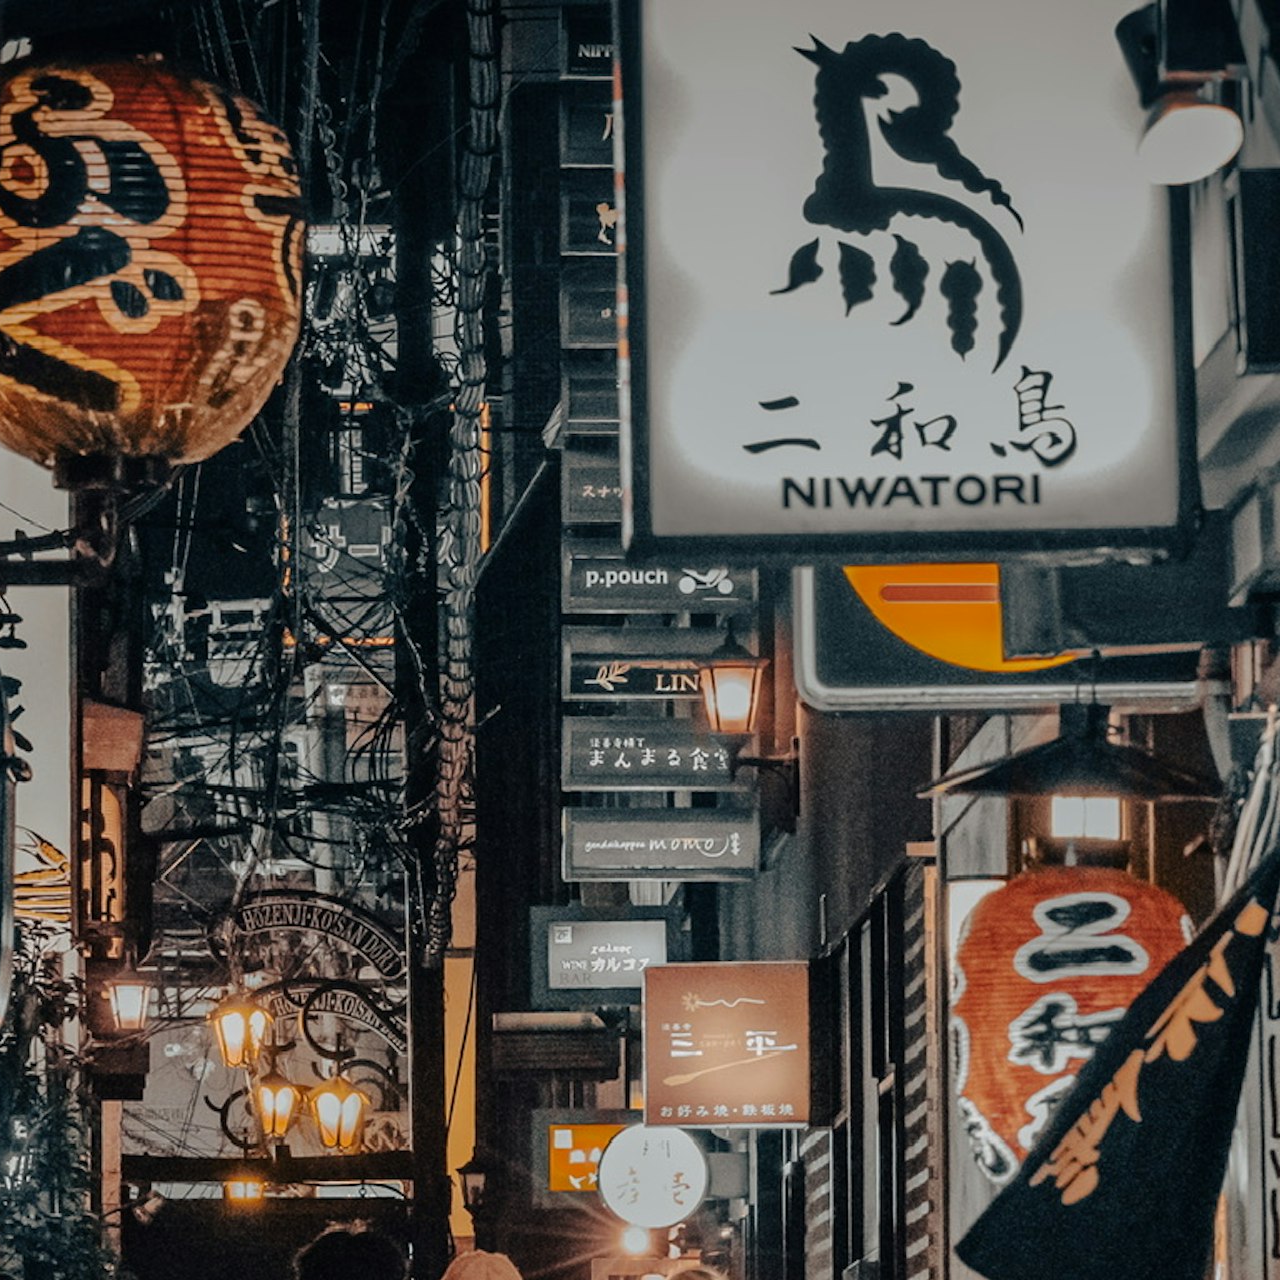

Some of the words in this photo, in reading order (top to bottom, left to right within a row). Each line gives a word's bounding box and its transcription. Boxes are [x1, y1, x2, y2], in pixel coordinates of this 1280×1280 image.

[743, 365, 1077, 467] 二和鳥
[781, 474, 1043, 509] NIWATORI
[585, 568, 669, 588] p.pouch
[559, 973, 593, 985] BAR
